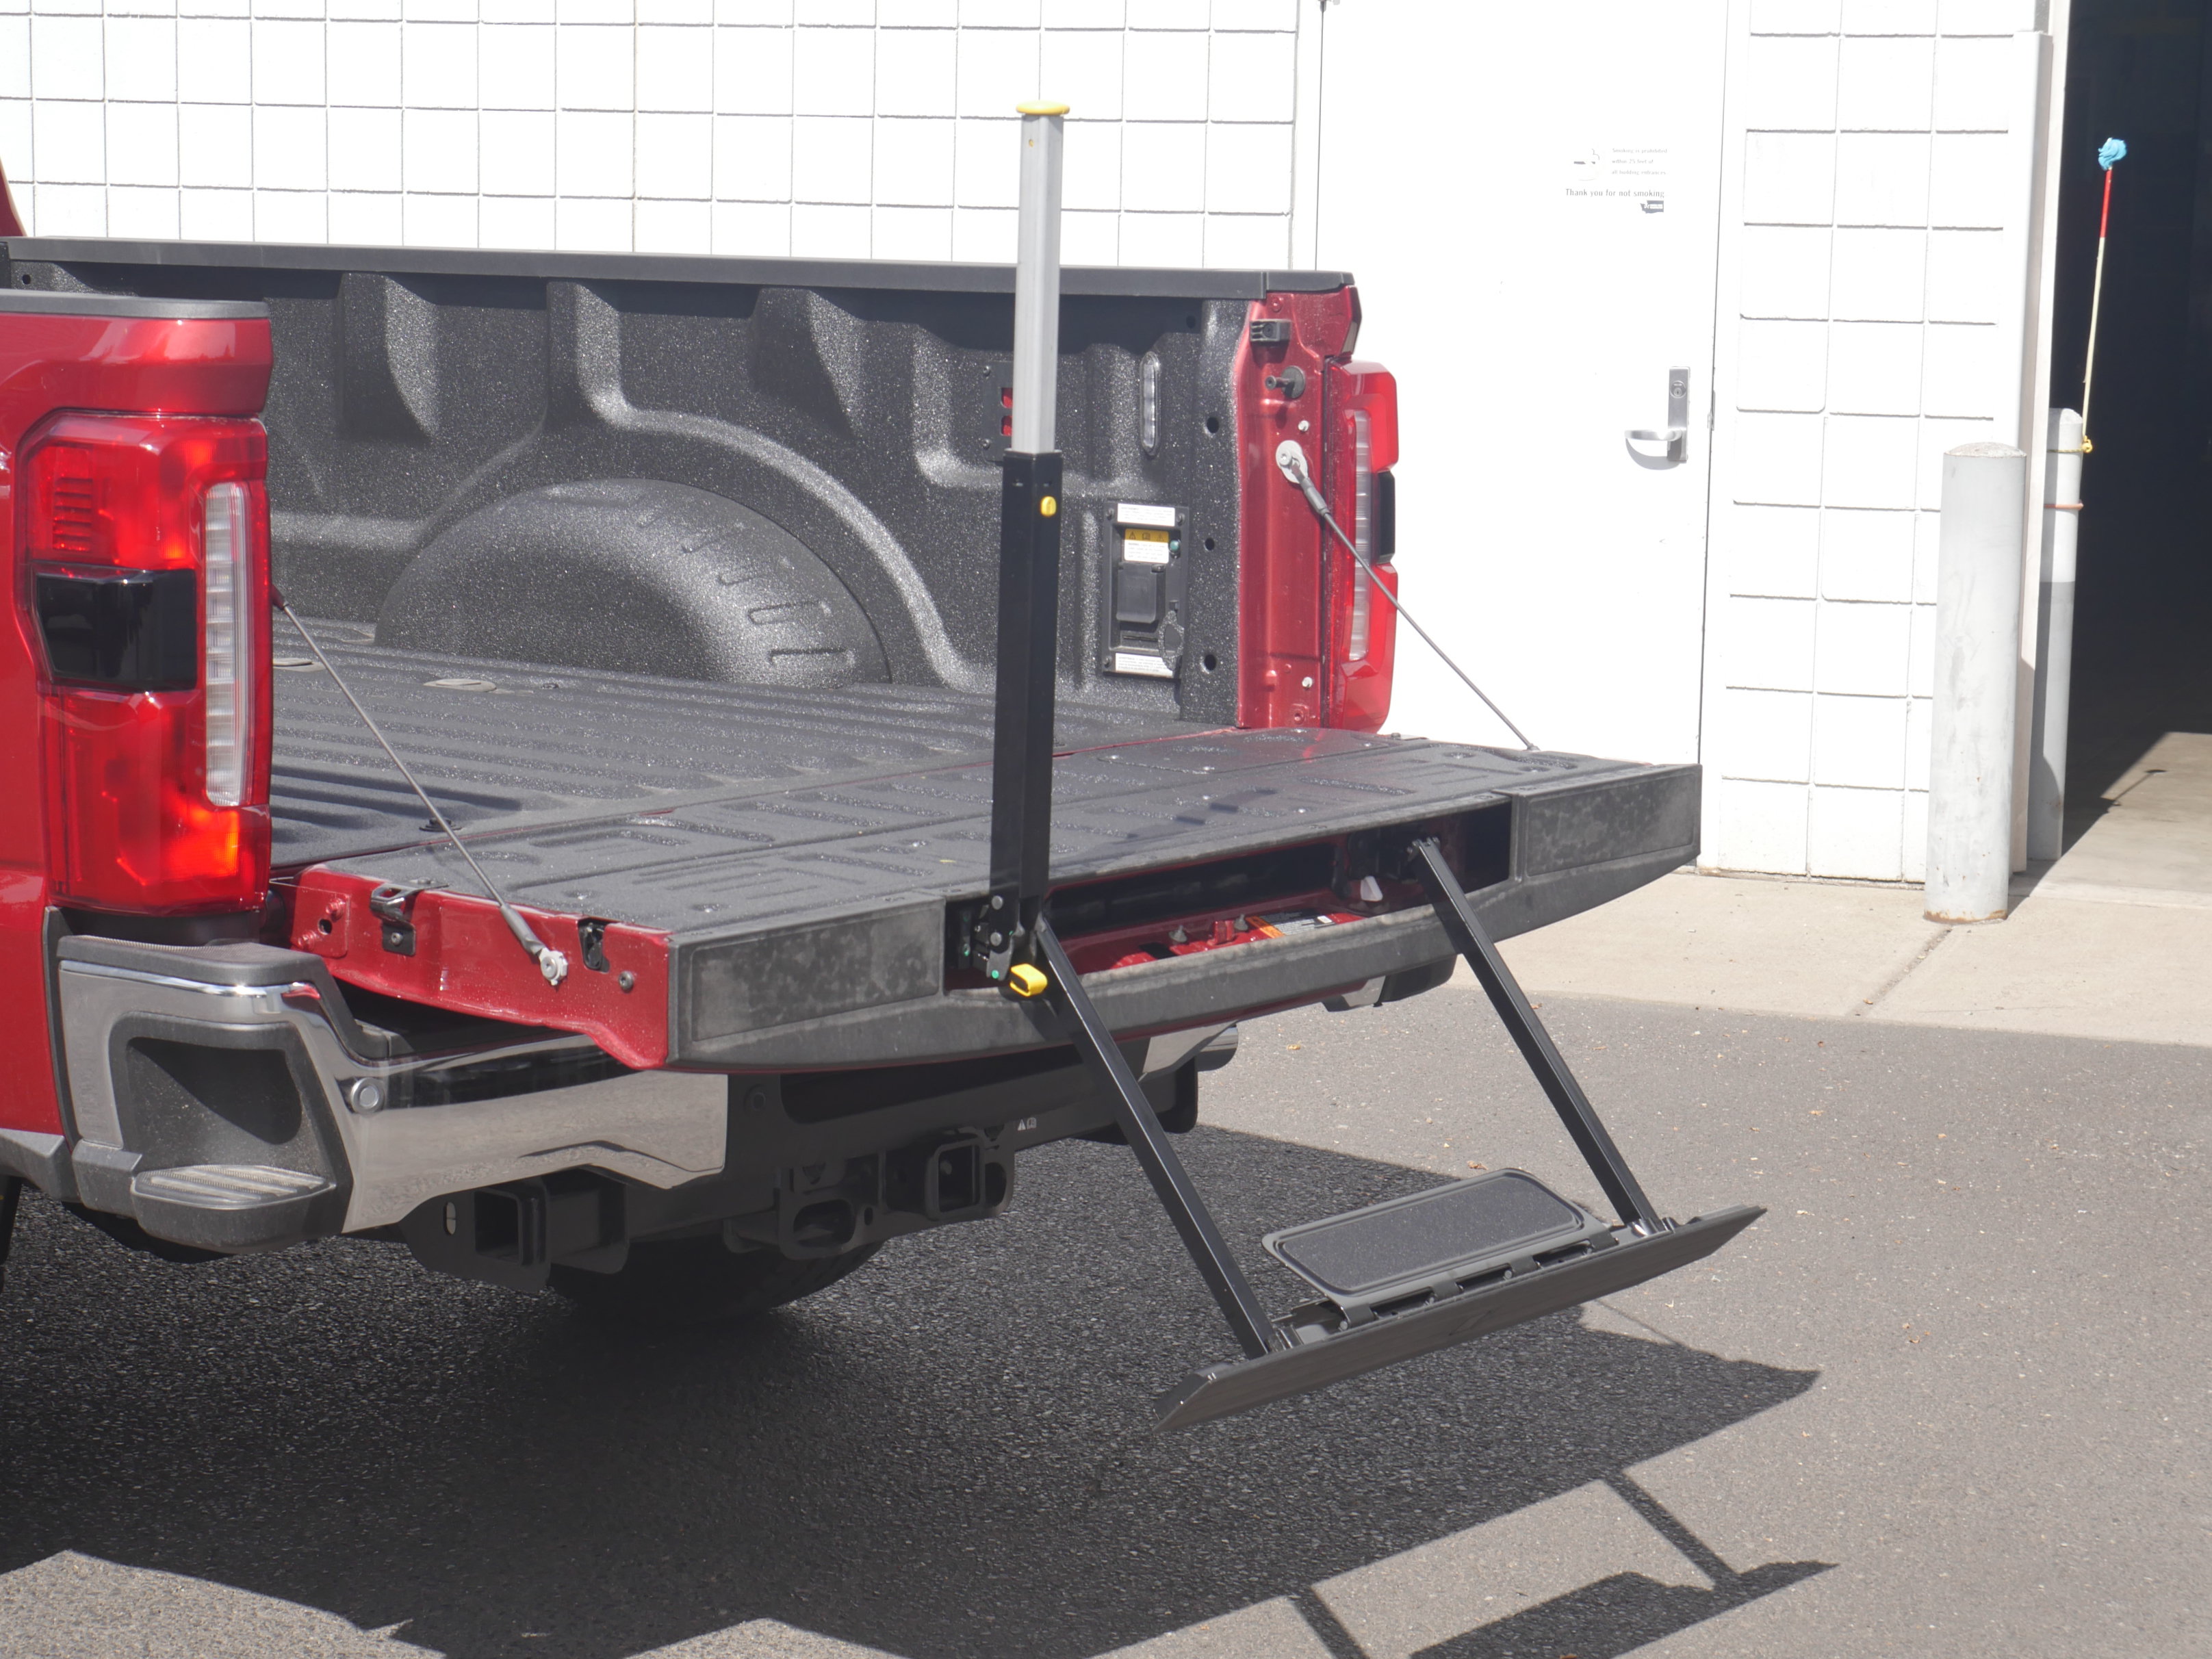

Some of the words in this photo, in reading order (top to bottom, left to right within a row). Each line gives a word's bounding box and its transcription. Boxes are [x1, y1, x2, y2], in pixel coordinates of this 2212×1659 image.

[1566, 188, 1589, 196] Thank
[1606, 189, 1617, 197] for
[1633, 190, 1664, 198] smoking
